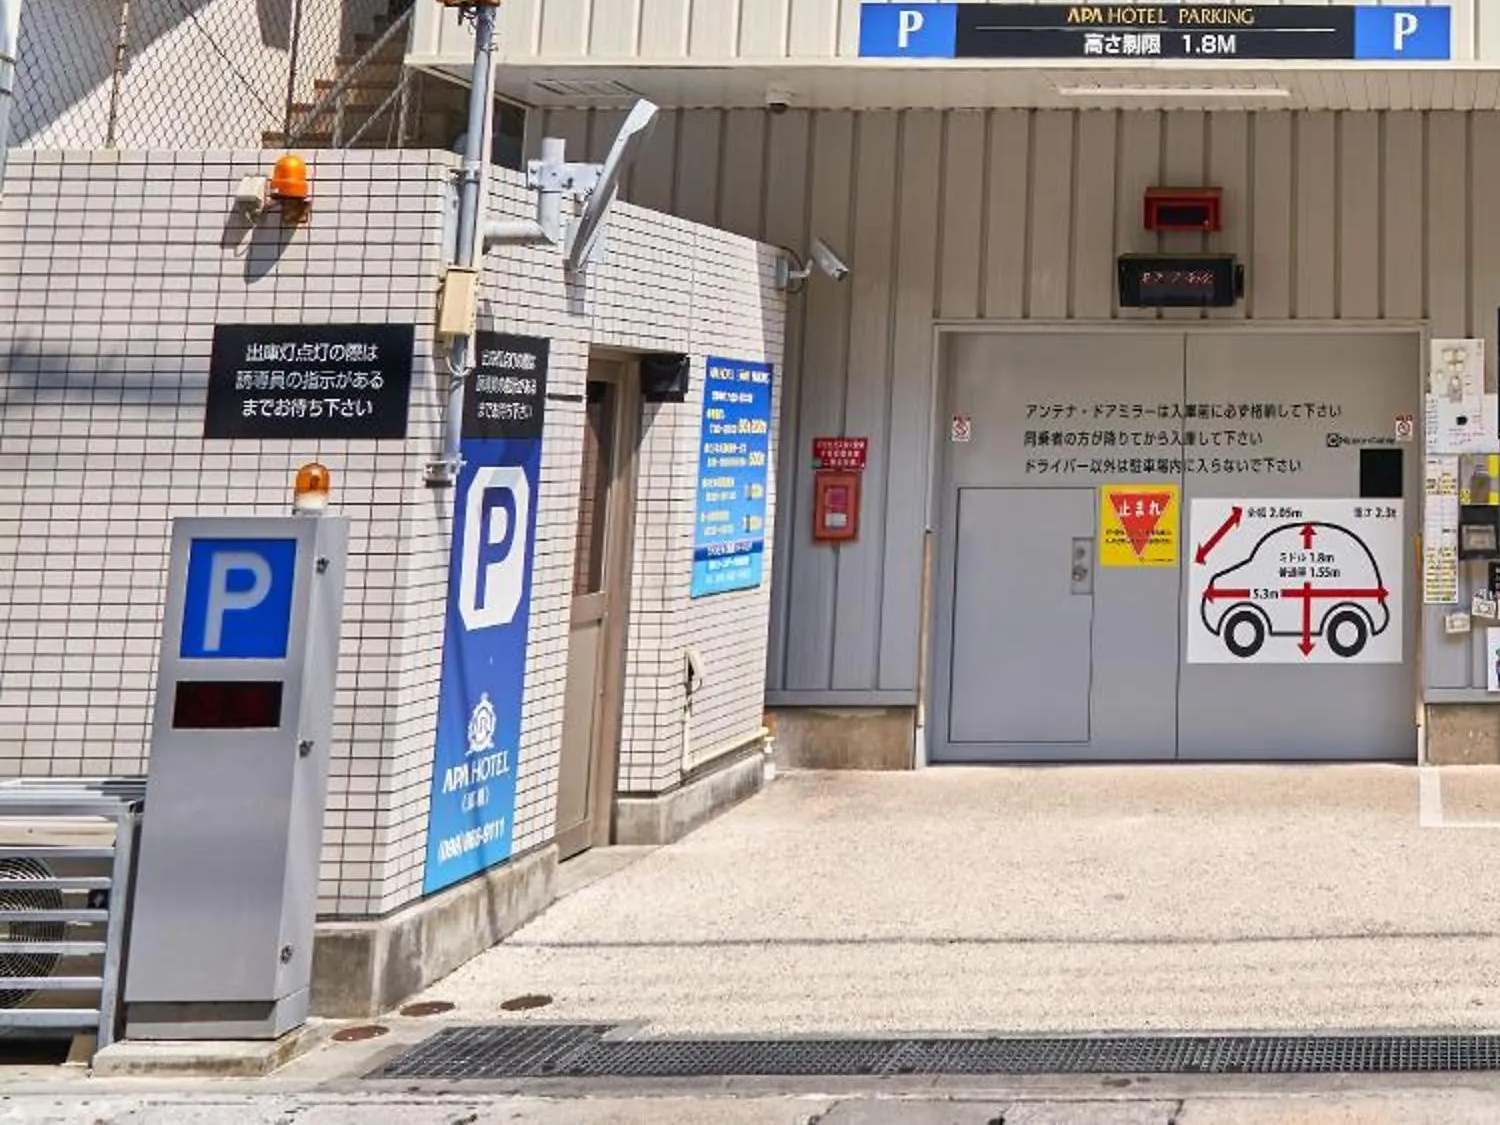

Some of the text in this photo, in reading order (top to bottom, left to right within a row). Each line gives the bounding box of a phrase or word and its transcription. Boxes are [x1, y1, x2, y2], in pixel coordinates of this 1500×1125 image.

[1067, 7, 1255, 24] APA HOTEL PARKING
[898, 10, 924, 48] P
[1393, 12, 1418, 50] P
[1084, 33, 1237, 54] 高さ制限 1.8M
[245, 342, 379, 362] 出庫灯点灯の際は
[235, 370, 385, 390] 誘導員の指示がある
[241, 398, 374, 417] までお待ち下さい
[1118, 499, 1161, 518] 止まれ
[473, 487, 517, 610] P
[1310, 552, 1335, 563] 1.8m
[203, 551, 273, 652] P
[1252, 589, 1279, 600] 5.3m
[442, 750, 510, 794] APA HOTEL
